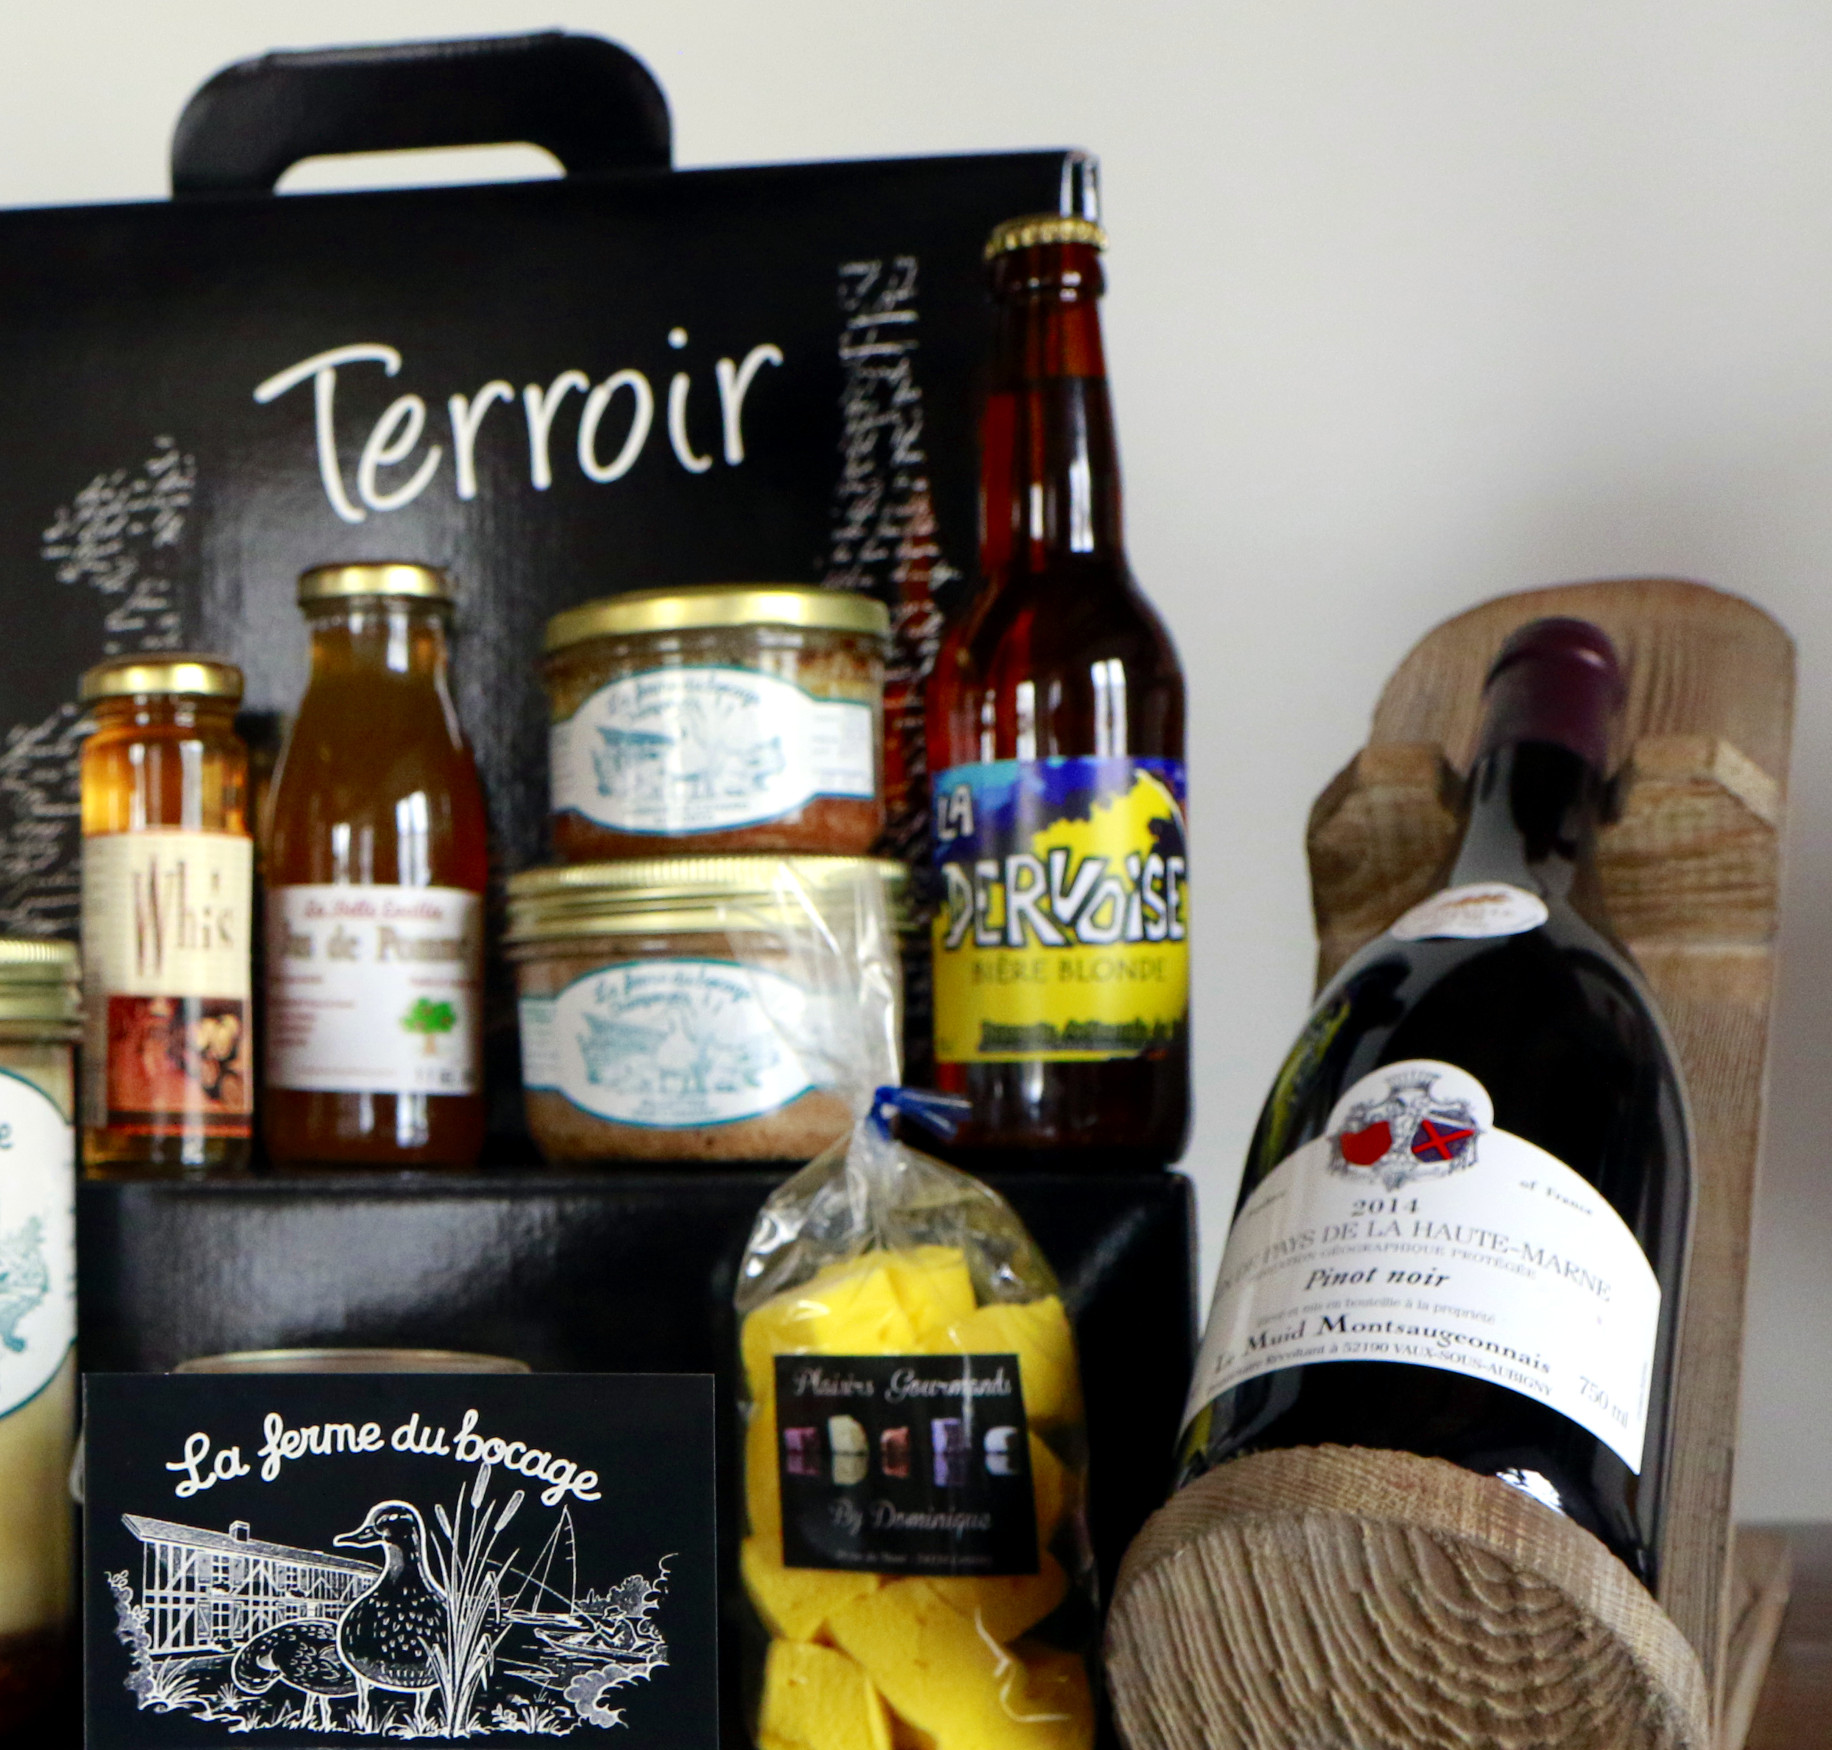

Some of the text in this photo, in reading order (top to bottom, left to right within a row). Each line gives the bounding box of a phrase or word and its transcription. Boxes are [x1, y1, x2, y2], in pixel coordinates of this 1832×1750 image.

[254, 327, 784, 524] Terroir
[936, 784, 975, 841] LA
[940, 847, 1186, 949] DERVOISE
[1058, 956, 1168, 984] BLONDE
[1351, 1198, 1419, 1217] 2014
[1304, 1267, 1451, 1291] Pinot noir
[1322, 1222, 1359, 1243] DE
[1367, 1219, 1402, 1238] LA
[1413, 1220, 1612, 1302] HAUTE-MARNE
[1243, 1320, 1307, 1356] Muid
[1317, 1313, 1551, 1374] Montsaugeonnais
[166, 1408, 603, 1507] La ferme du bocage
